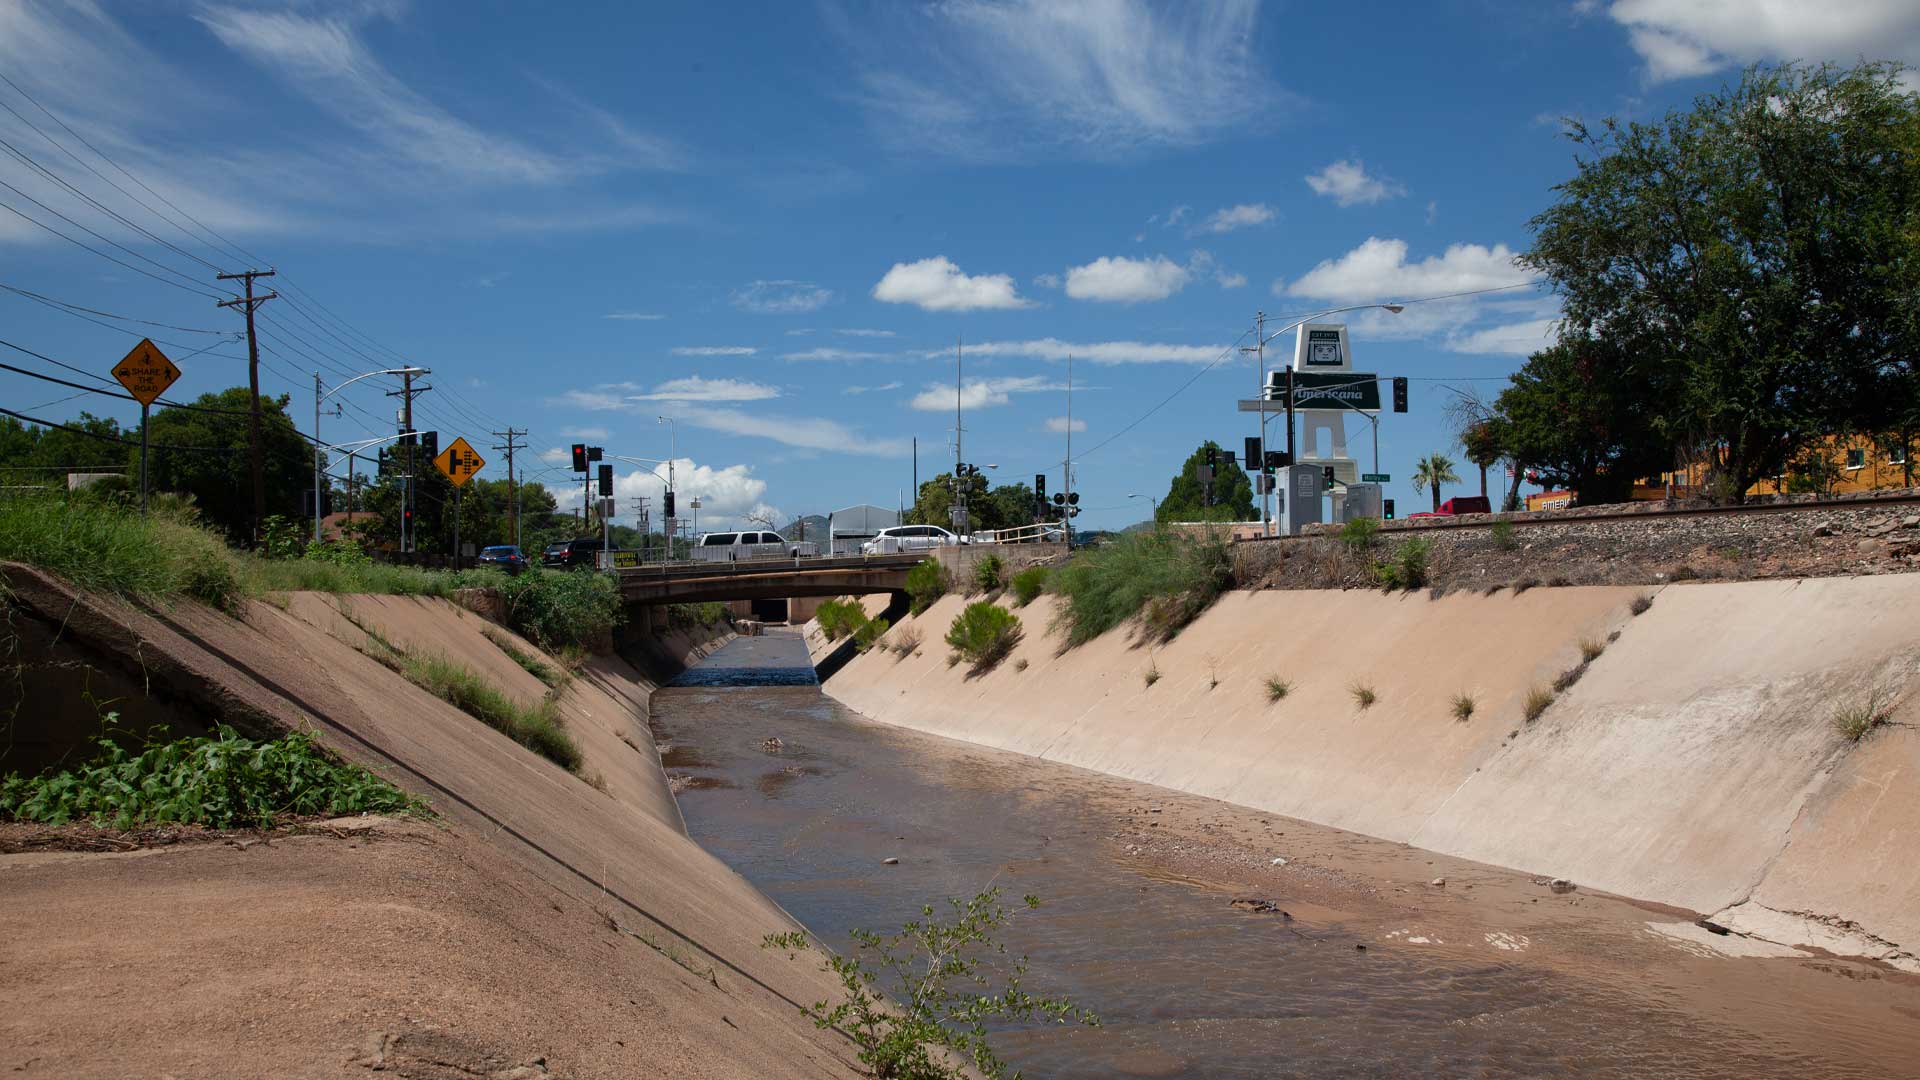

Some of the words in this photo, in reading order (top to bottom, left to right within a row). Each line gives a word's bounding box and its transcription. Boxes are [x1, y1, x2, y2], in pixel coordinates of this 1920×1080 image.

[131, 367, 160, 376] SHARE
[138, 376, 153, 384] THE
[134, 384, 158, 392] ROAD
[1294, 384, 1363, 400] Americana
